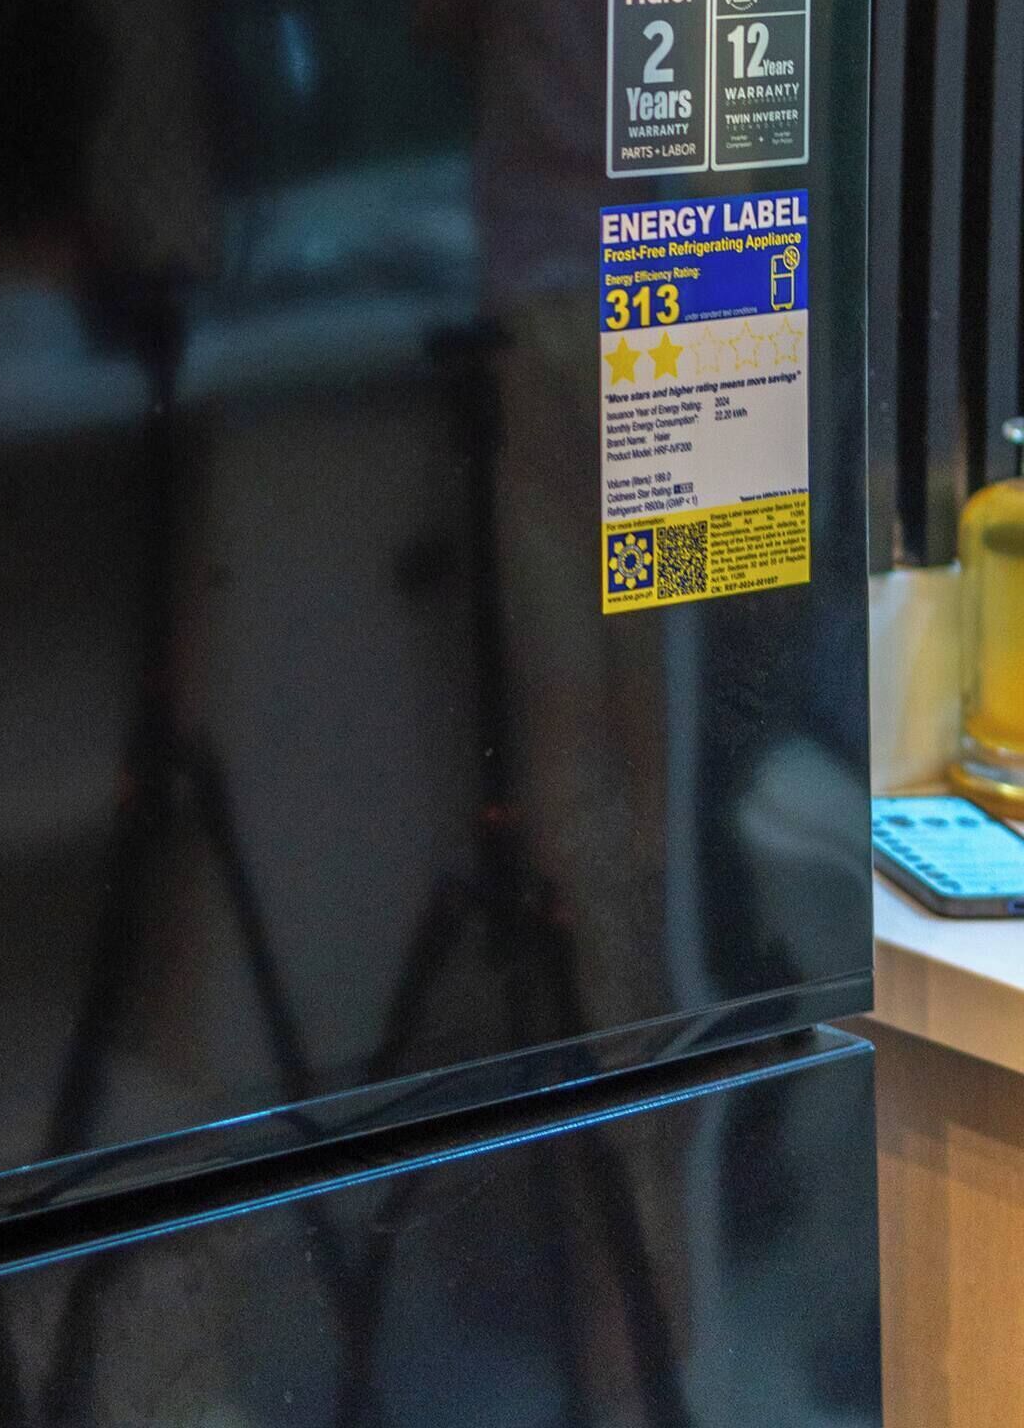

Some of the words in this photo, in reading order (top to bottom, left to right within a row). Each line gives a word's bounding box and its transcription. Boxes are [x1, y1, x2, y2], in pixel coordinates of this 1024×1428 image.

[643, 20, 674, 83] 2
[727, 22, 769, 79] 12
[763, 59, 794, 77] Years
[725, 82, 800, 101] WARRANTY
[626, 86, 692, 122] Years
[725, 112, 751, 125] TWIN
[753, 109, 798, 122] INVERTER
[628, 123, 689, 139] WARRANTY
[621, 145, 654, 159] PARTS
[661, 142, 696, 157] LABOR
[602, 204, 716, 244] ENERGY
[723, 196, 807, 232] LABEL
[604, 245, 666, 263] Frost-Free
[668, 236, 743, 257] Refrigerating
[745, 232, 801, 251] Appliance
[605, 273, 633, 287] Energy
[634, 269, 672, 285] Efficiency
[605, 284, 680, 330] 313
[631, 391, 651, 401] stars
[652, 387, 667, 398] and
[669, 385, 694, 398] higher
[695, 382, 718, 393] rating
[720, 379, 745, 389] means
[747, 377, 766, 386] more
[658, 404, 680, 414] Energy
[607, 424, 631, 434] Monthly
[632, 421, 654, 432] Energy
[607, 438, 625, 449] Brand
[607, 451, 631, 462] Product
[607, 479, 630, 489] Volume
